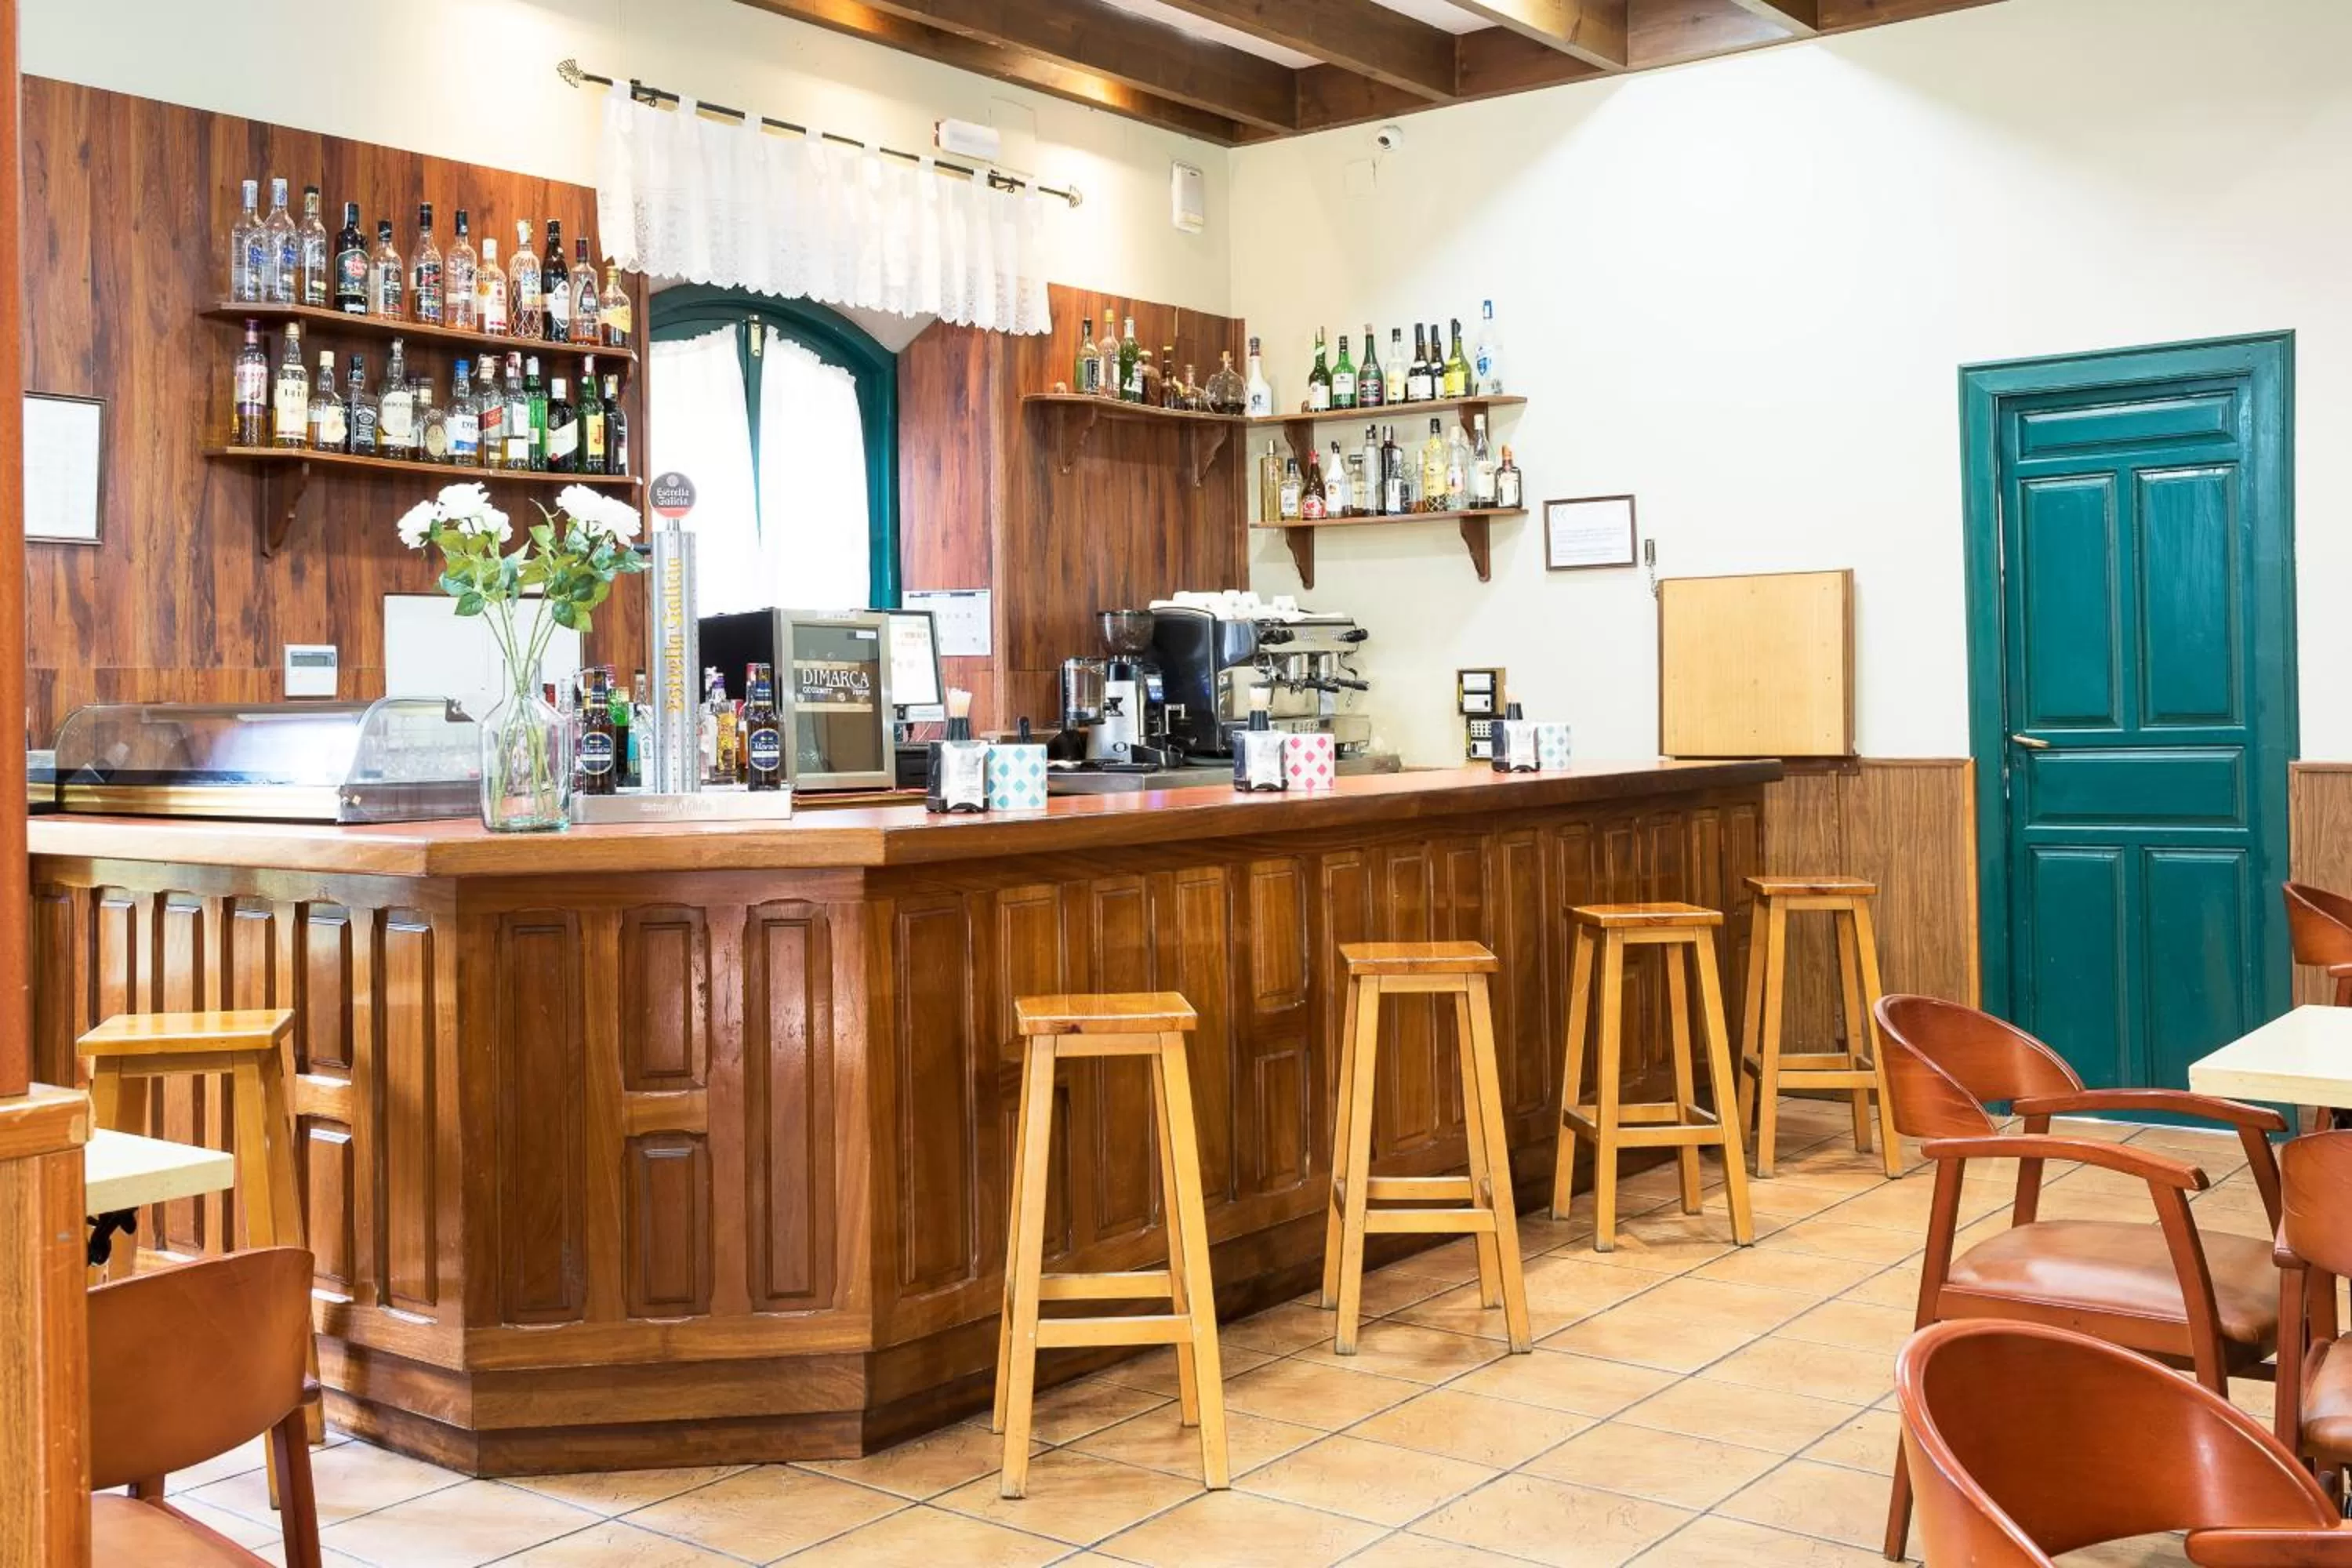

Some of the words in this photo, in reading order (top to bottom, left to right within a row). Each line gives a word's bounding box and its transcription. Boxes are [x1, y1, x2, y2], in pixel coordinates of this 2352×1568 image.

[656, 488, 689, 496] Estrella
[657, 496, 688, 506] Galicia
[662, 557, 683, 629] Galicia
[664, 633, 684, 713] Estrella
[802, 669, 869, 689] DIMARCA
